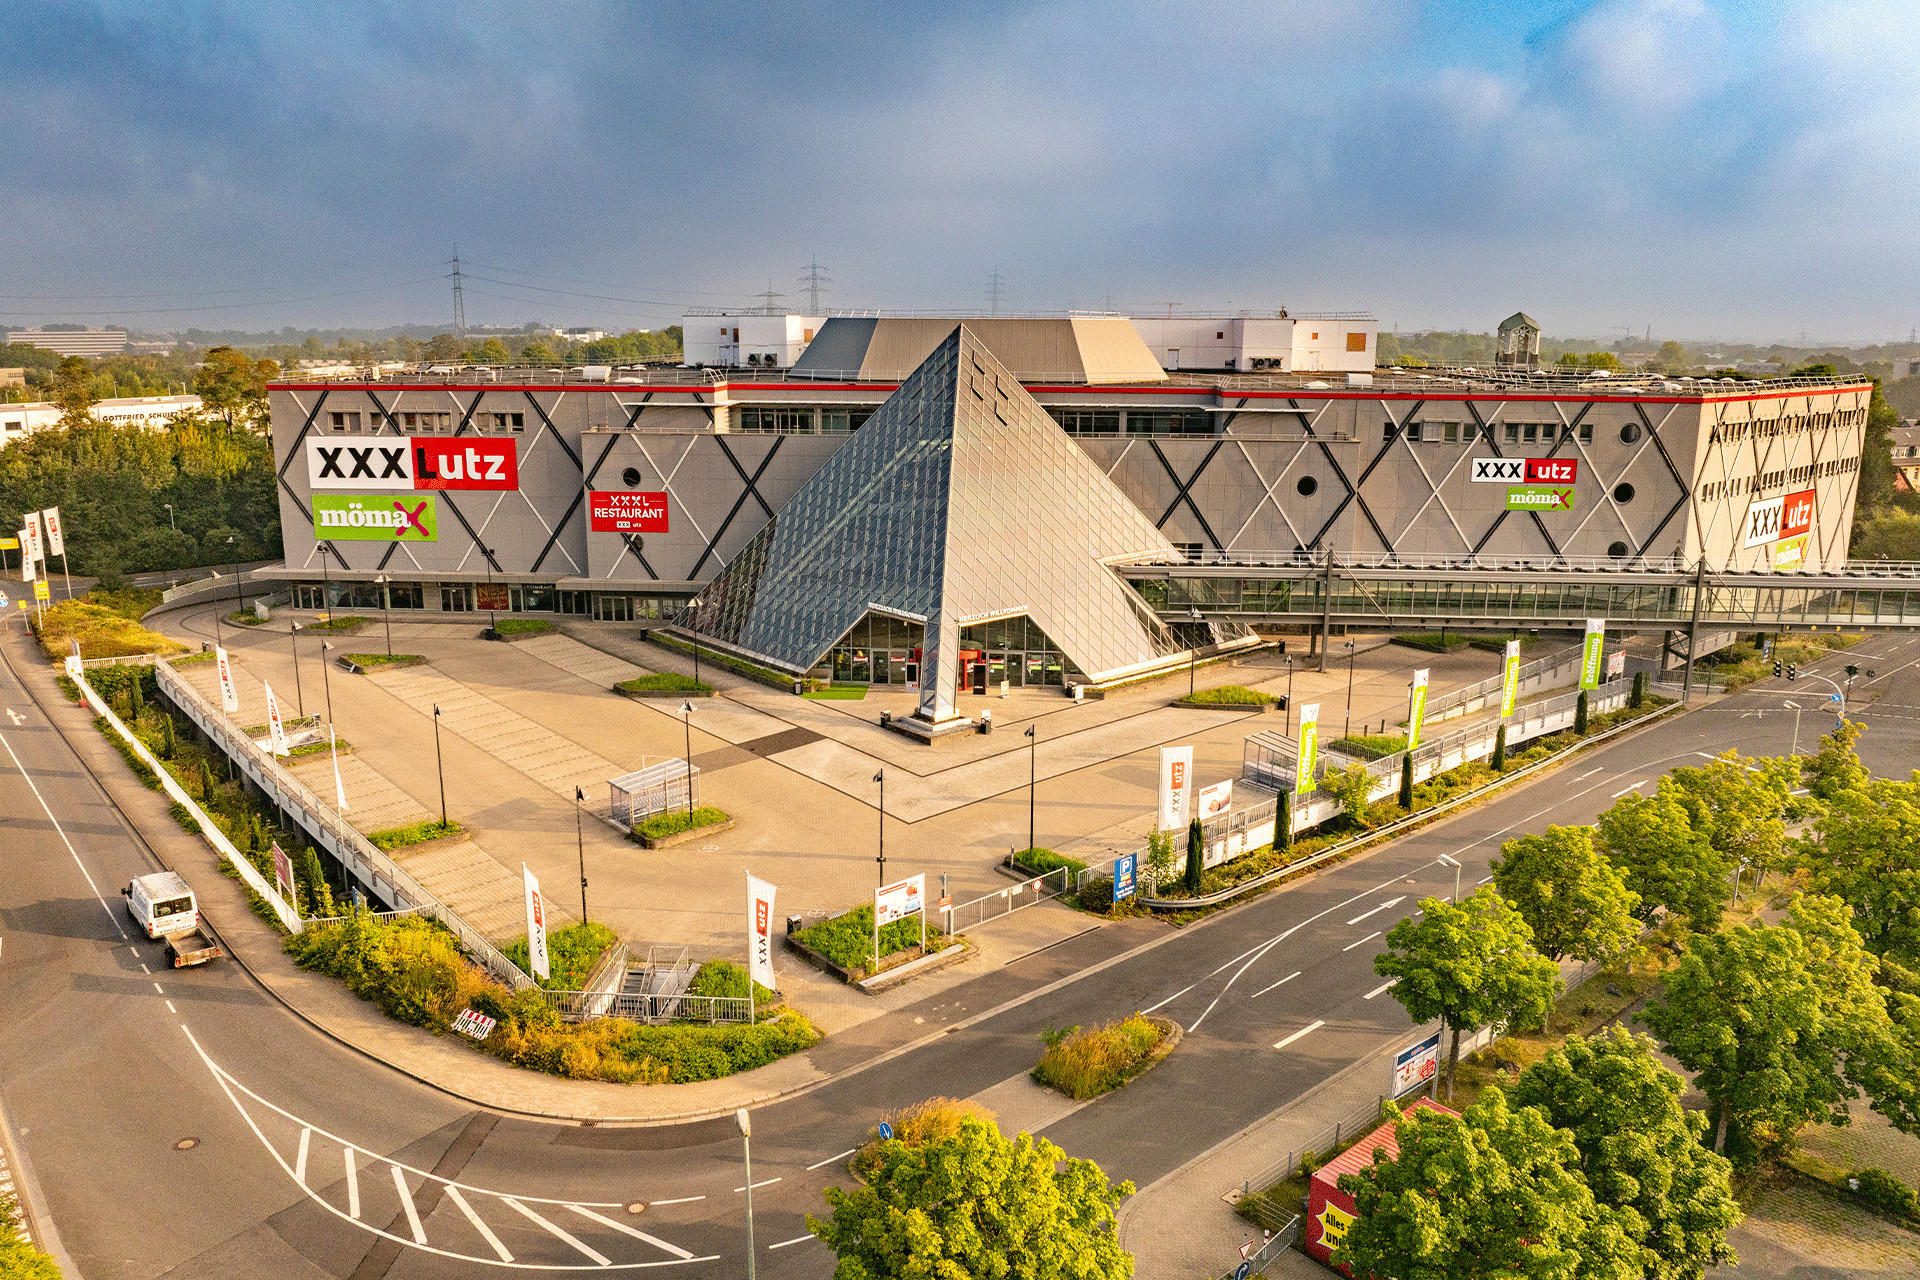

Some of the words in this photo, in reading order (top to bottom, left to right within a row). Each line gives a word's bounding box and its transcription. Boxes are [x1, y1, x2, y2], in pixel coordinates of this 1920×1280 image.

[103, 413, 145, 422] GOTTFRIED
[610, 495, 650, 507] XXXL
[594, 507, 664, 519] RESTAURANT
[959, 612, 989, 622] HERZLICH
[990, 605, 1028, 617] WILLKOMMEN
[1585, 638, 1601, 684] Eröffnung
[1172, 764, 1183, 814] XXXutz
[1122, 860, 1130, 873] P
[1325, 1212, 1345, 1231] Alles
